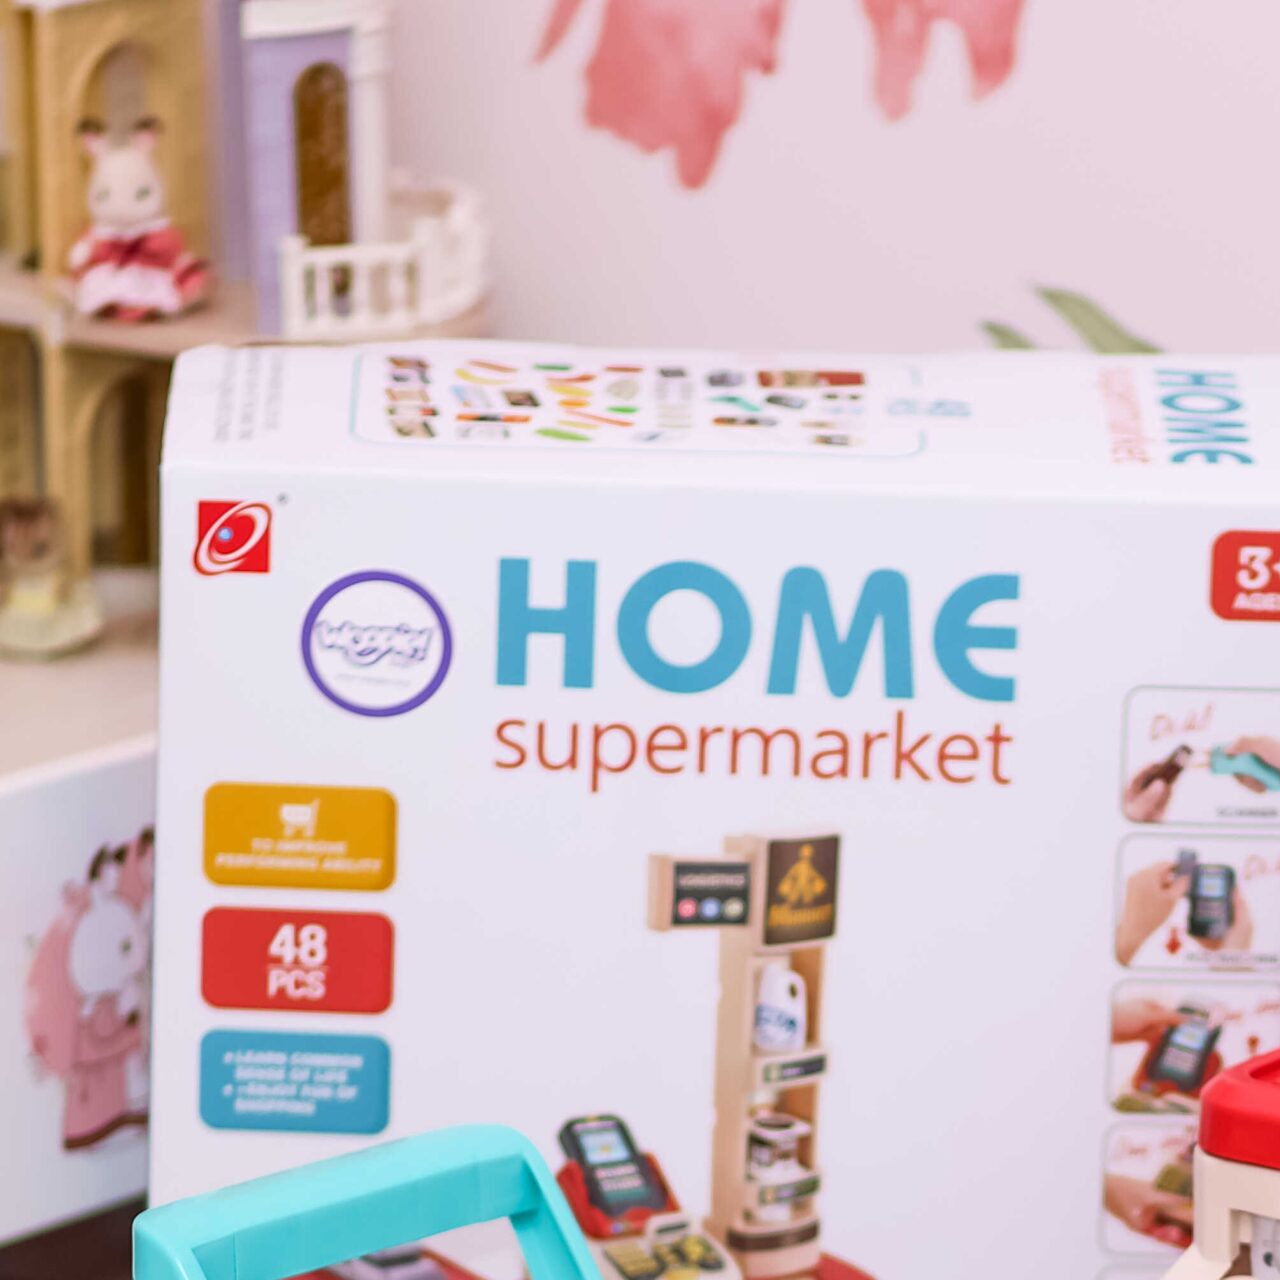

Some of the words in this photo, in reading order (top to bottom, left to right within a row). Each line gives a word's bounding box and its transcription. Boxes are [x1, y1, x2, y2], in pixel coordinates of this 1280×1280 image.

[496, 557, 1020, 704] HOME
[494, 710, 1014, 793] supermarket
[268, 922, 329, 967] 48
[266, 968, 327, 1001] PCS
